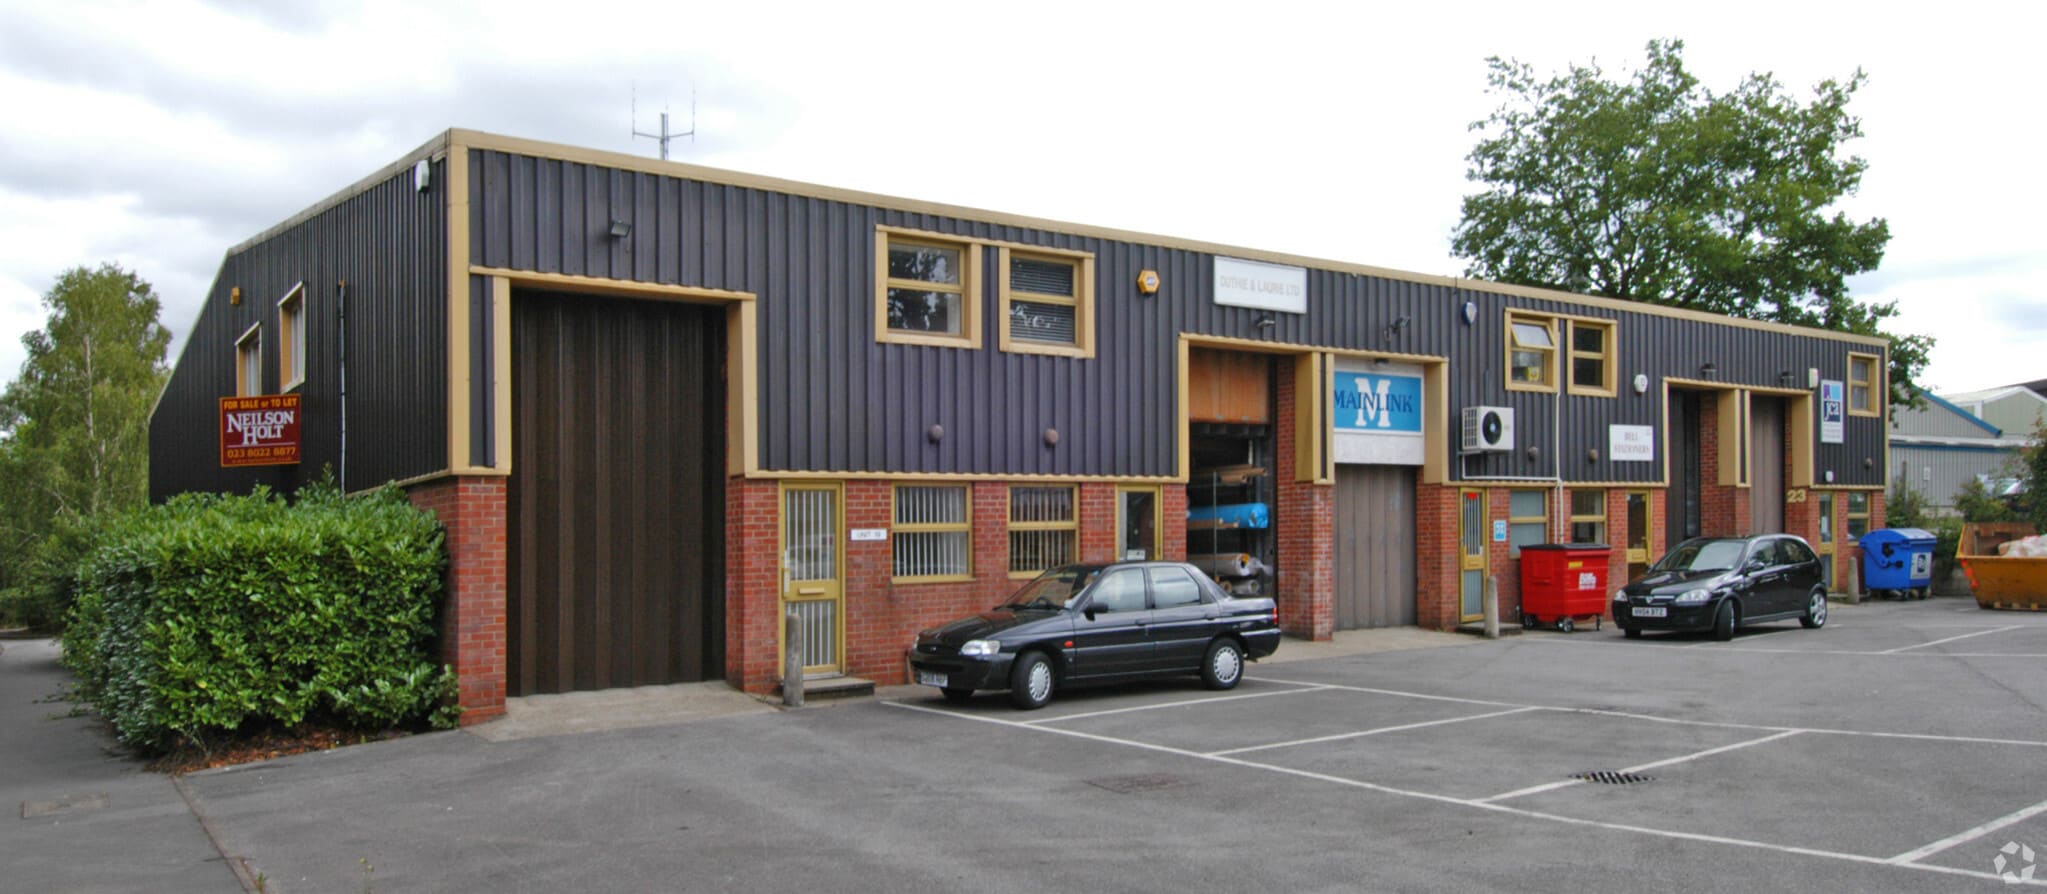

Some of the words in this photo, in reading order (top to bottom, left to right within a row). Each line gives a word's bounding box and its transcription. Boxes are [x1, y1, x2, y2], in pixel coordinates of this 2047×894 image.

[1286, 284, 1300, 296] LTD
[224, 401, 238, 409] FOR
[240, 400, 258, 408] SALE
[271, 399, 280, 407] TO
[283, 398, 297, 407] LET
[1334, 390, 1412, 413] MAINLINK
[227, 411, 294, 433] NEILSON
[243, 425, 284, 445] HOLT
[227, 449, 245, 458] 023
[1787, 489, 1806, 503] 23
